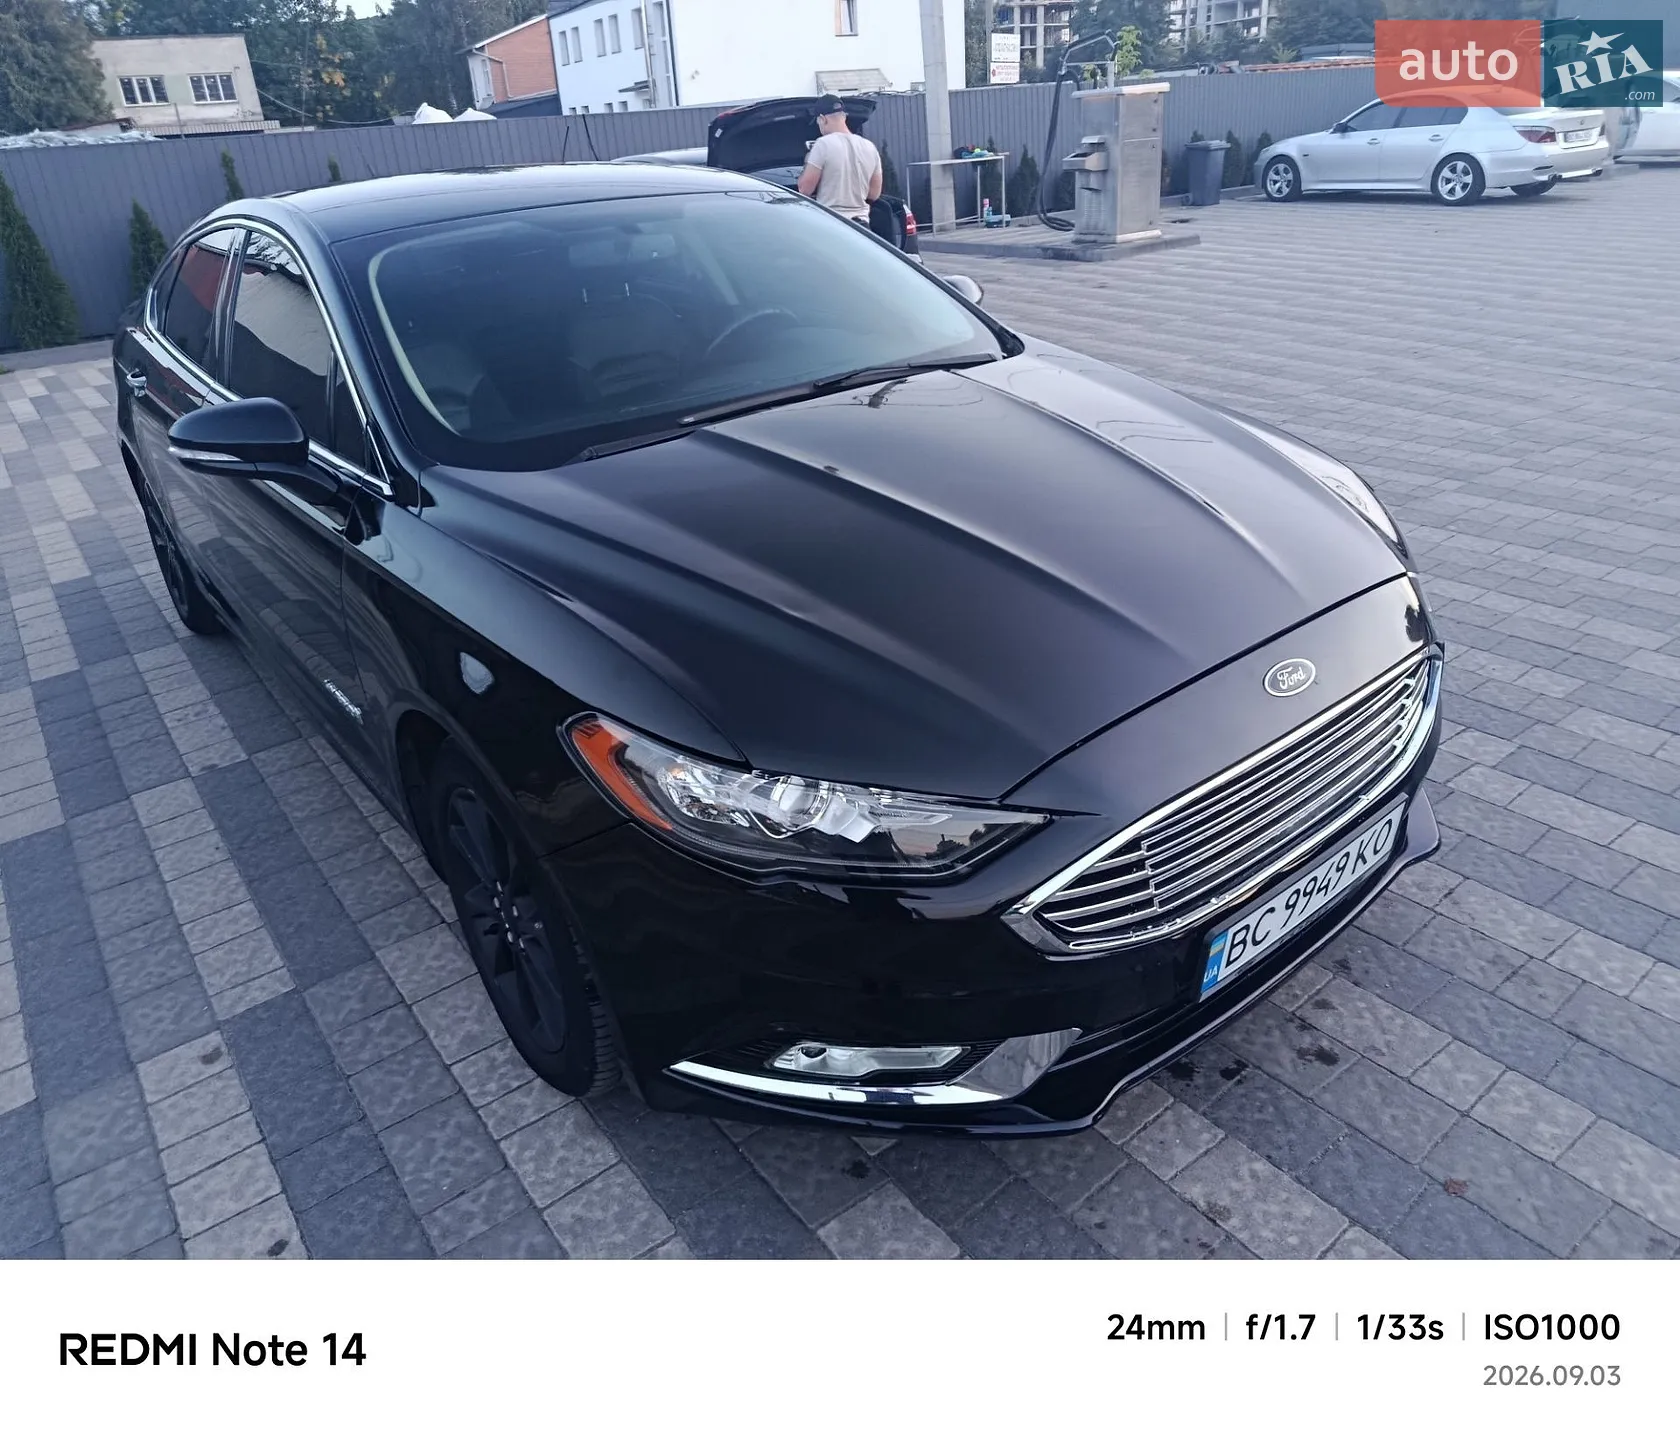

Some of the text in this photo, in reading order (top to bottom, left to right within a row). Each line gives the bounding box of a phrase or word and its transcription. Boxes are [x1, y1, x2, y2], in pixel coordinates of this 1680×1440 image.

[1277, 666, 1306, 690] Ford
[1225, 818, 1393, 969] BC 9949 KO
[1203, 965, 1218, 982] UA
